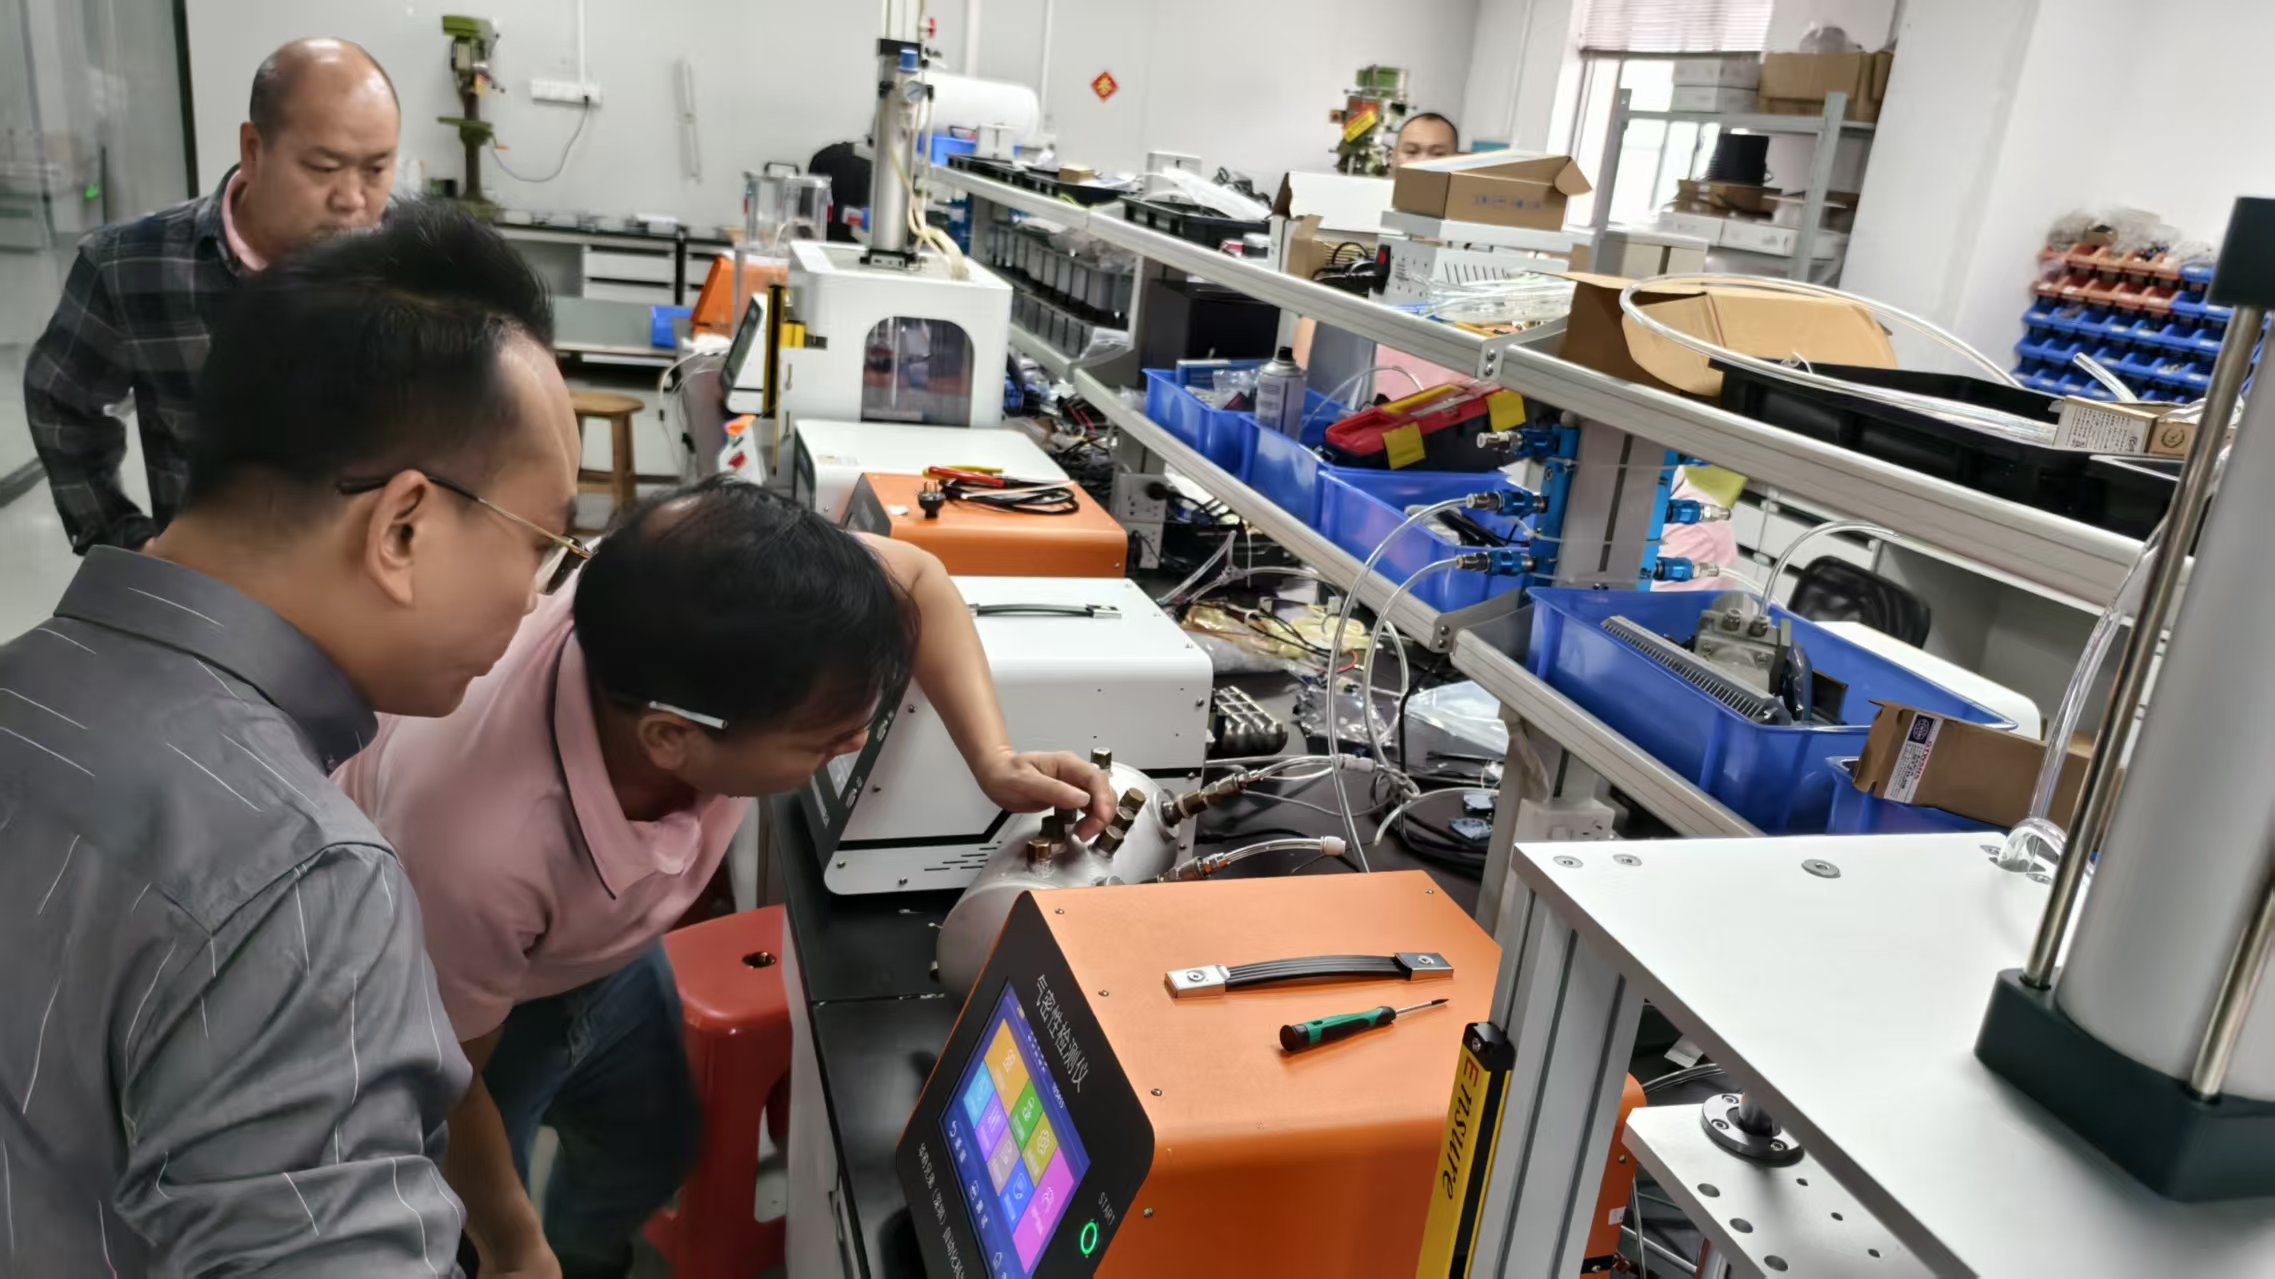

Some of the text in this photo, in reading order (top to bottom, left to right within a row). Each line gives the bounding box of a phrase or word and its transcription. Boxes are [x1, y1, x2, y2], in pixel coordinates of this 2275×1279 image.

[1037, 974, 1088, 1093] 气密性检测仪
[1098, 1191, 1115, 1225] START
